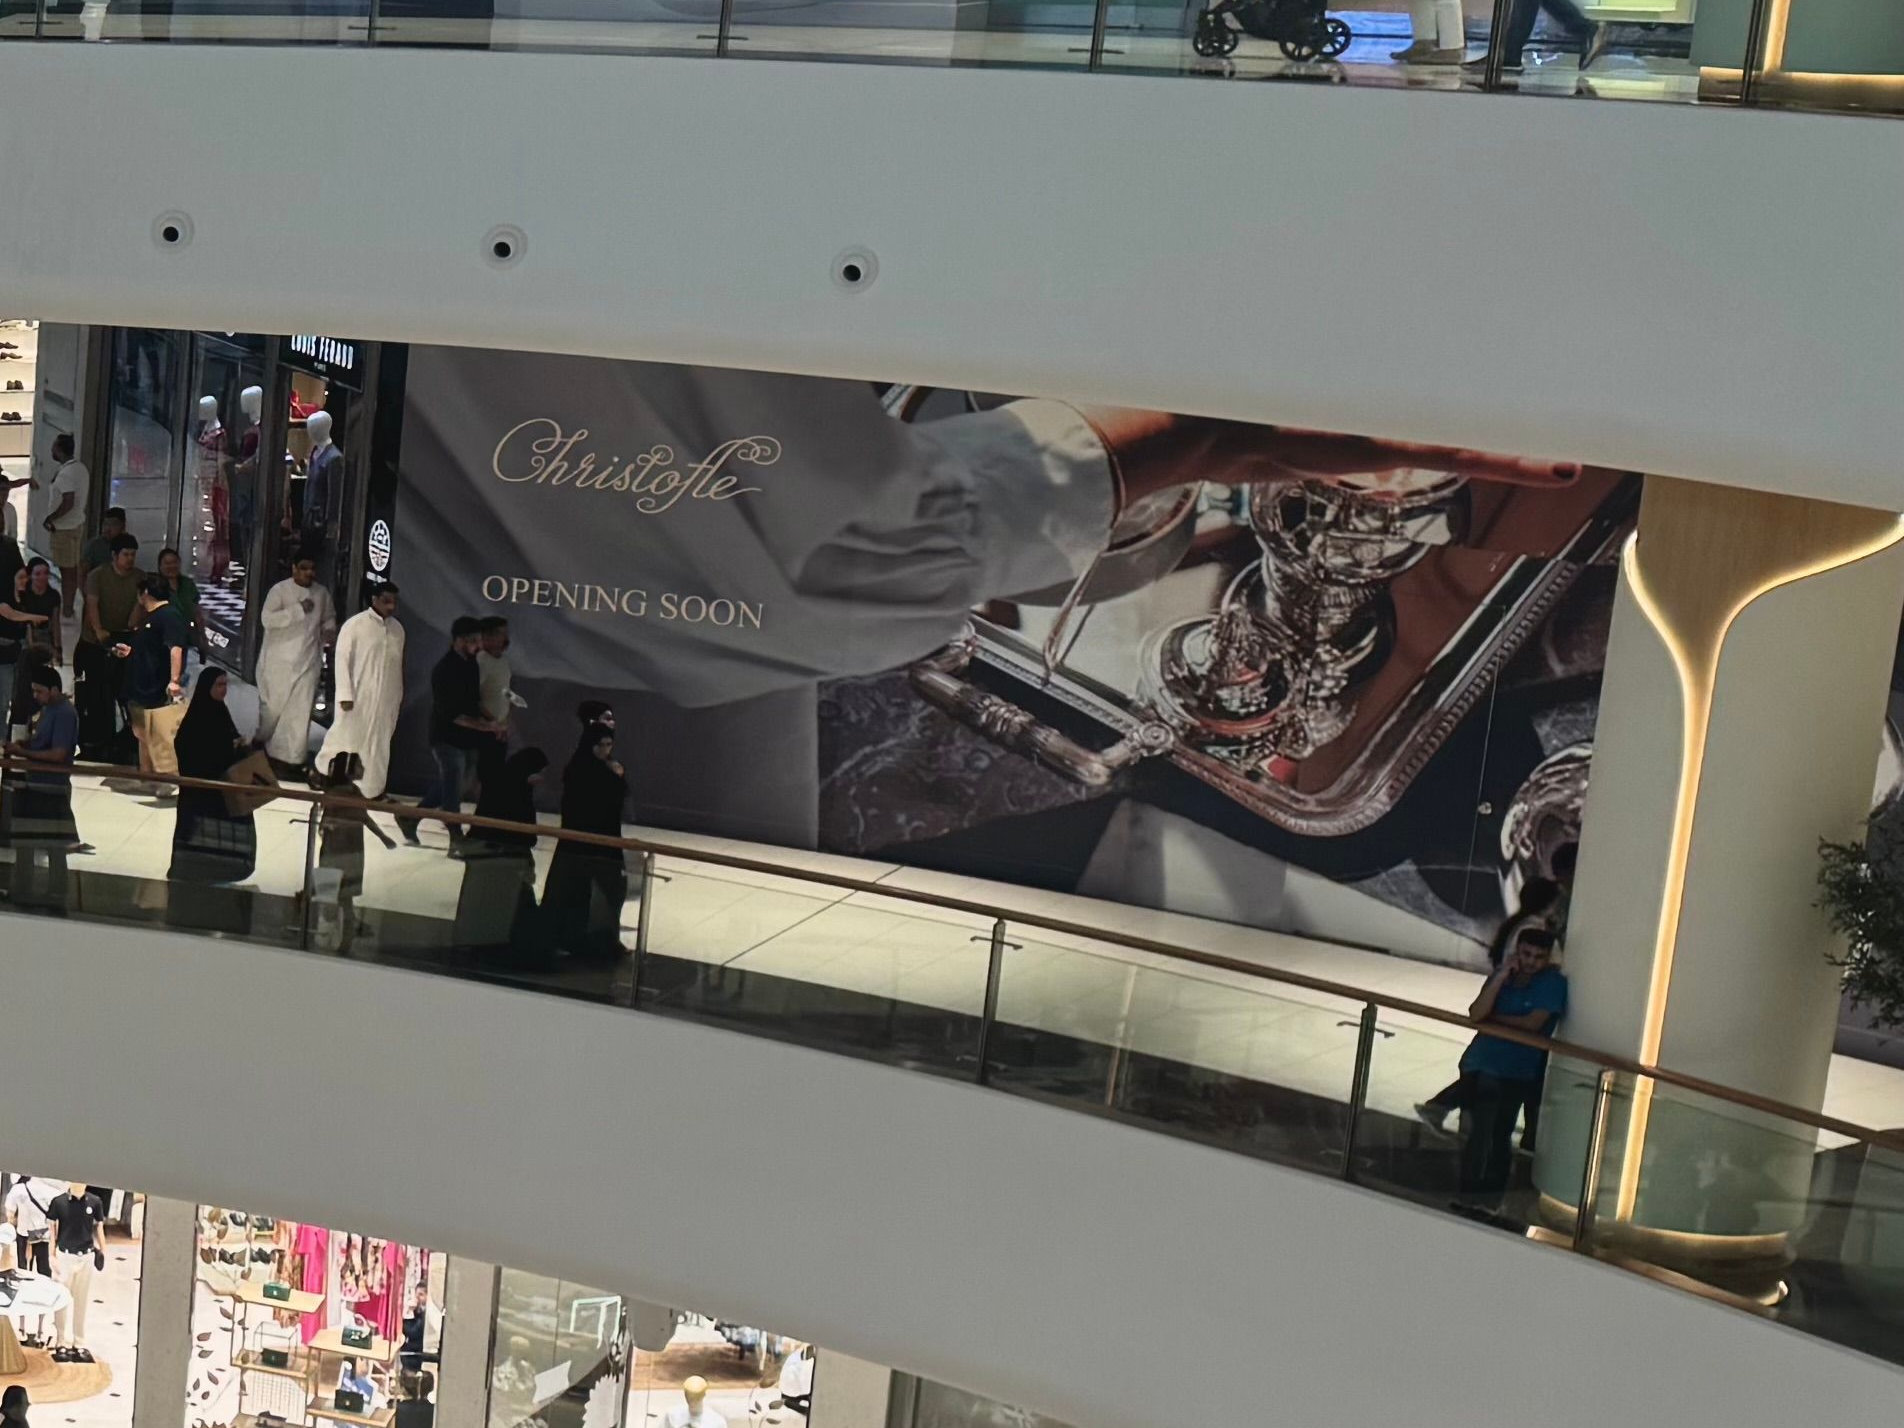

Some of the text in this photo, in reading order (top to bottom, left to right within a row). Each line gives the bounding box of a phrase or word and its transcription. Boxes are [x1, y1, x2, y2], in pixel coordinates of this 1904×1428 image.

[493, 418, 782, 514] Christofle
[482, 574, 764, 630] OPENING SOON
